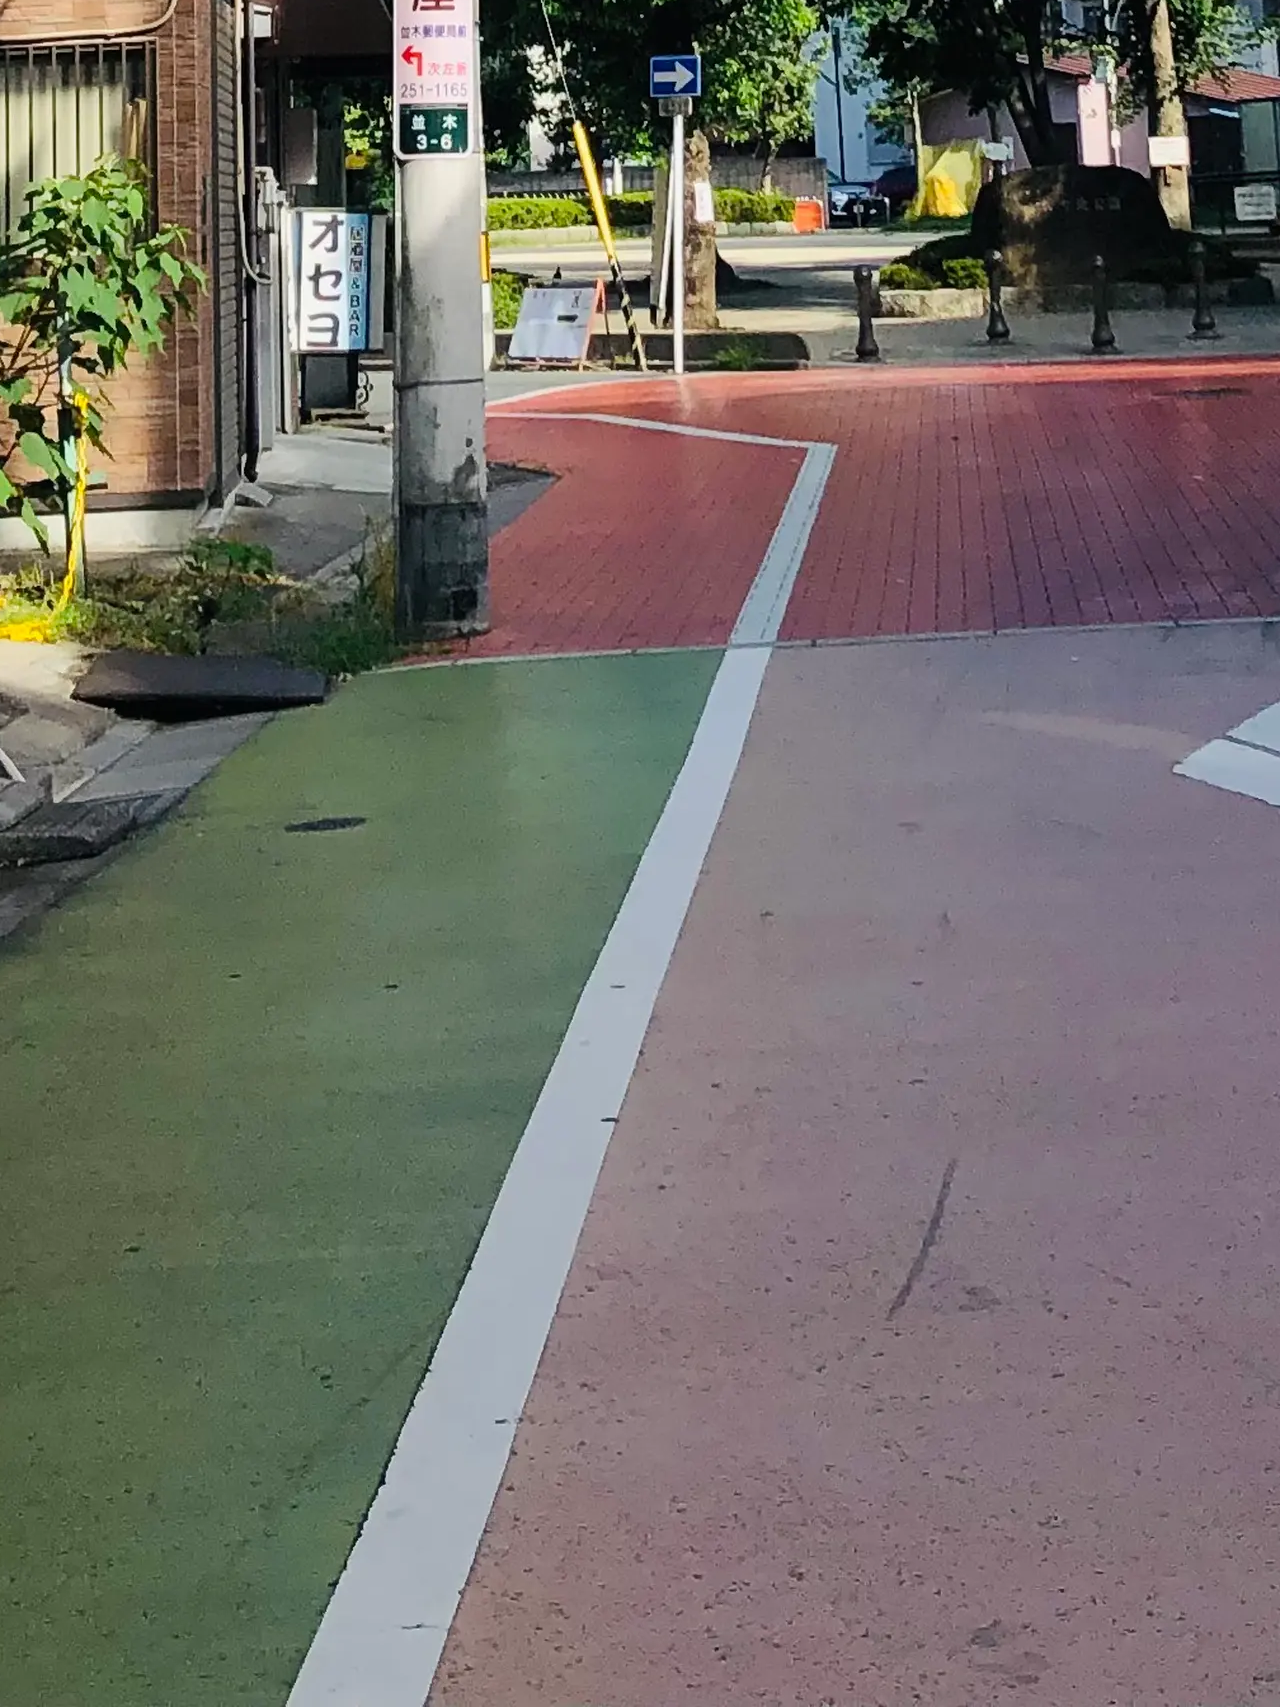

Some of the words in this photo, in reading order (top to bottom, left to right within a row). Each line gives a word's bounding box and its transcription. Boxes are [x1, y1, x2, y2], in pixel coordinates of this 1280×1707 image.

[400, 83, 468, 99] 251-1165
[416, 133, 453, 151] 3-6
[306, 214, 345, 347] オセヨ
